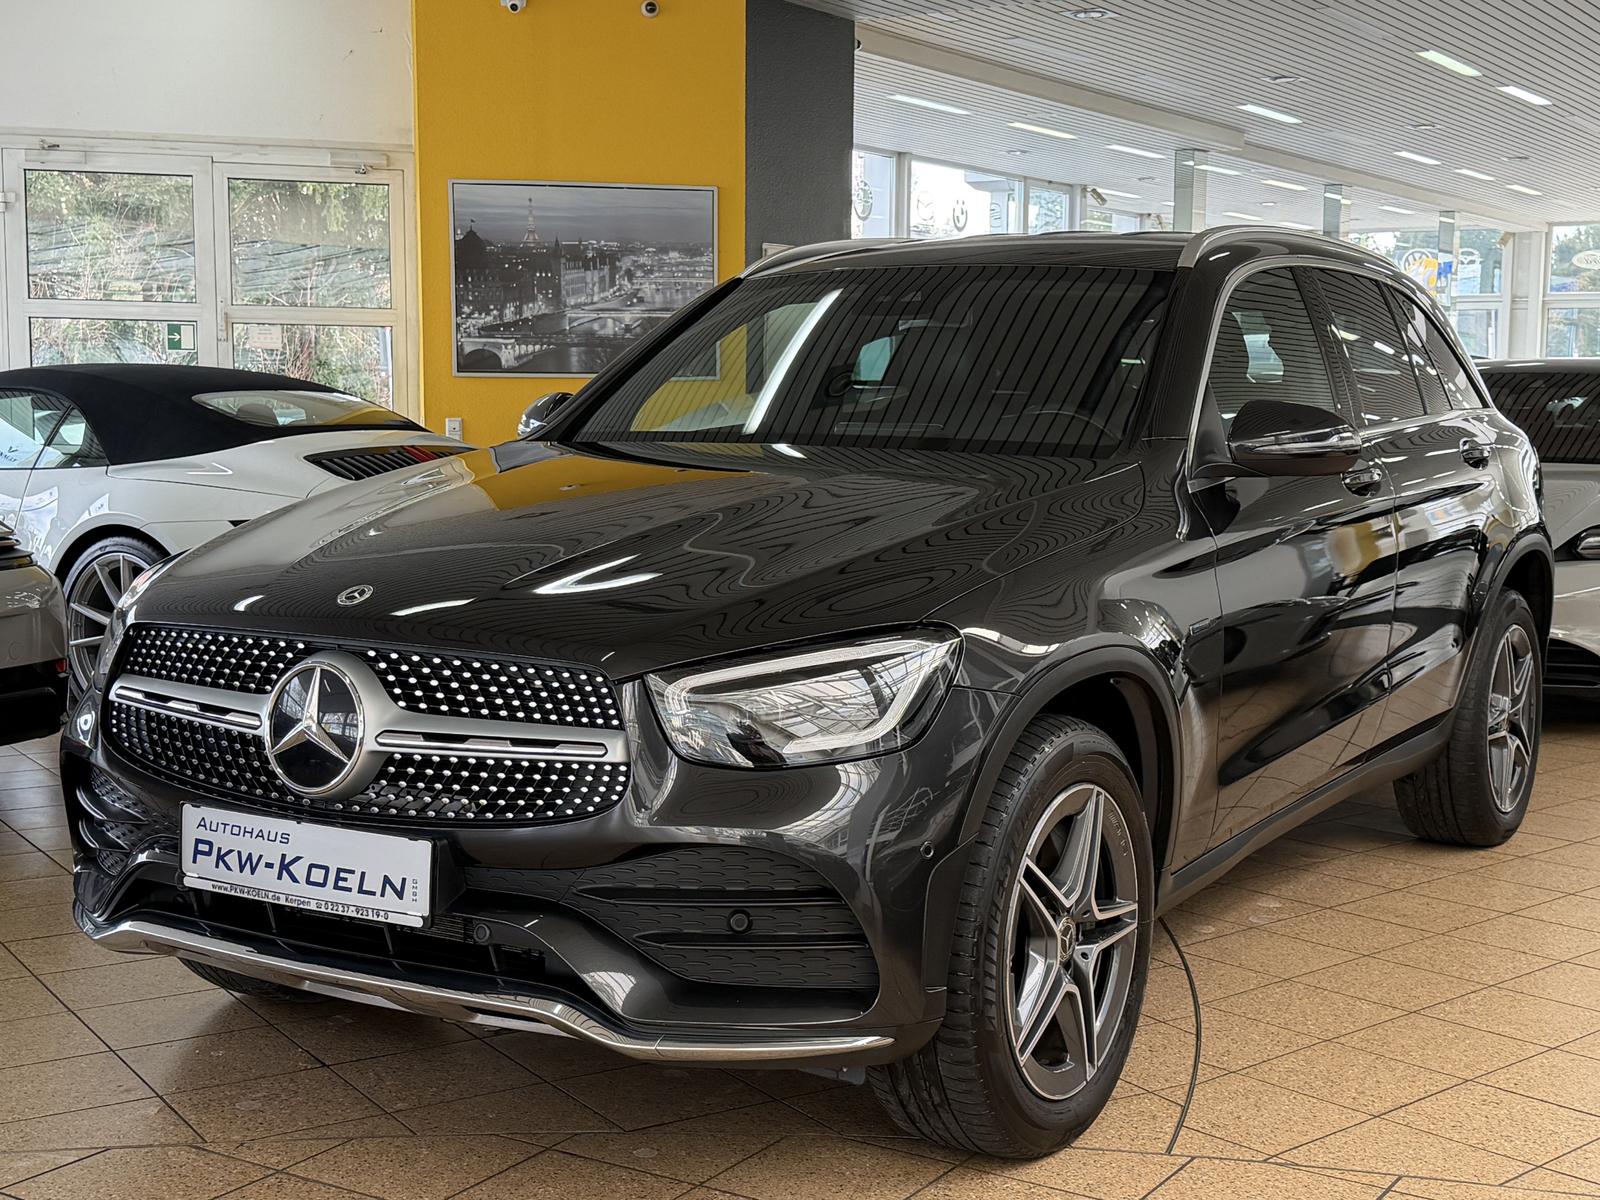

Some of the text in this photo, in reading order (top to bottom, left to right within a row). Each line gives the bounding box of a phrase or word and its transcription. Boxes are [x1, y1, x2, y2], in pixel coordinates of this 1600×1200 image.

[196, 816, 291, 845] AUTOHAUS
[191, 837, 407, 901] PKW-KOELN
[211, 882, 281, 902] www.PKW-KOELN.de
